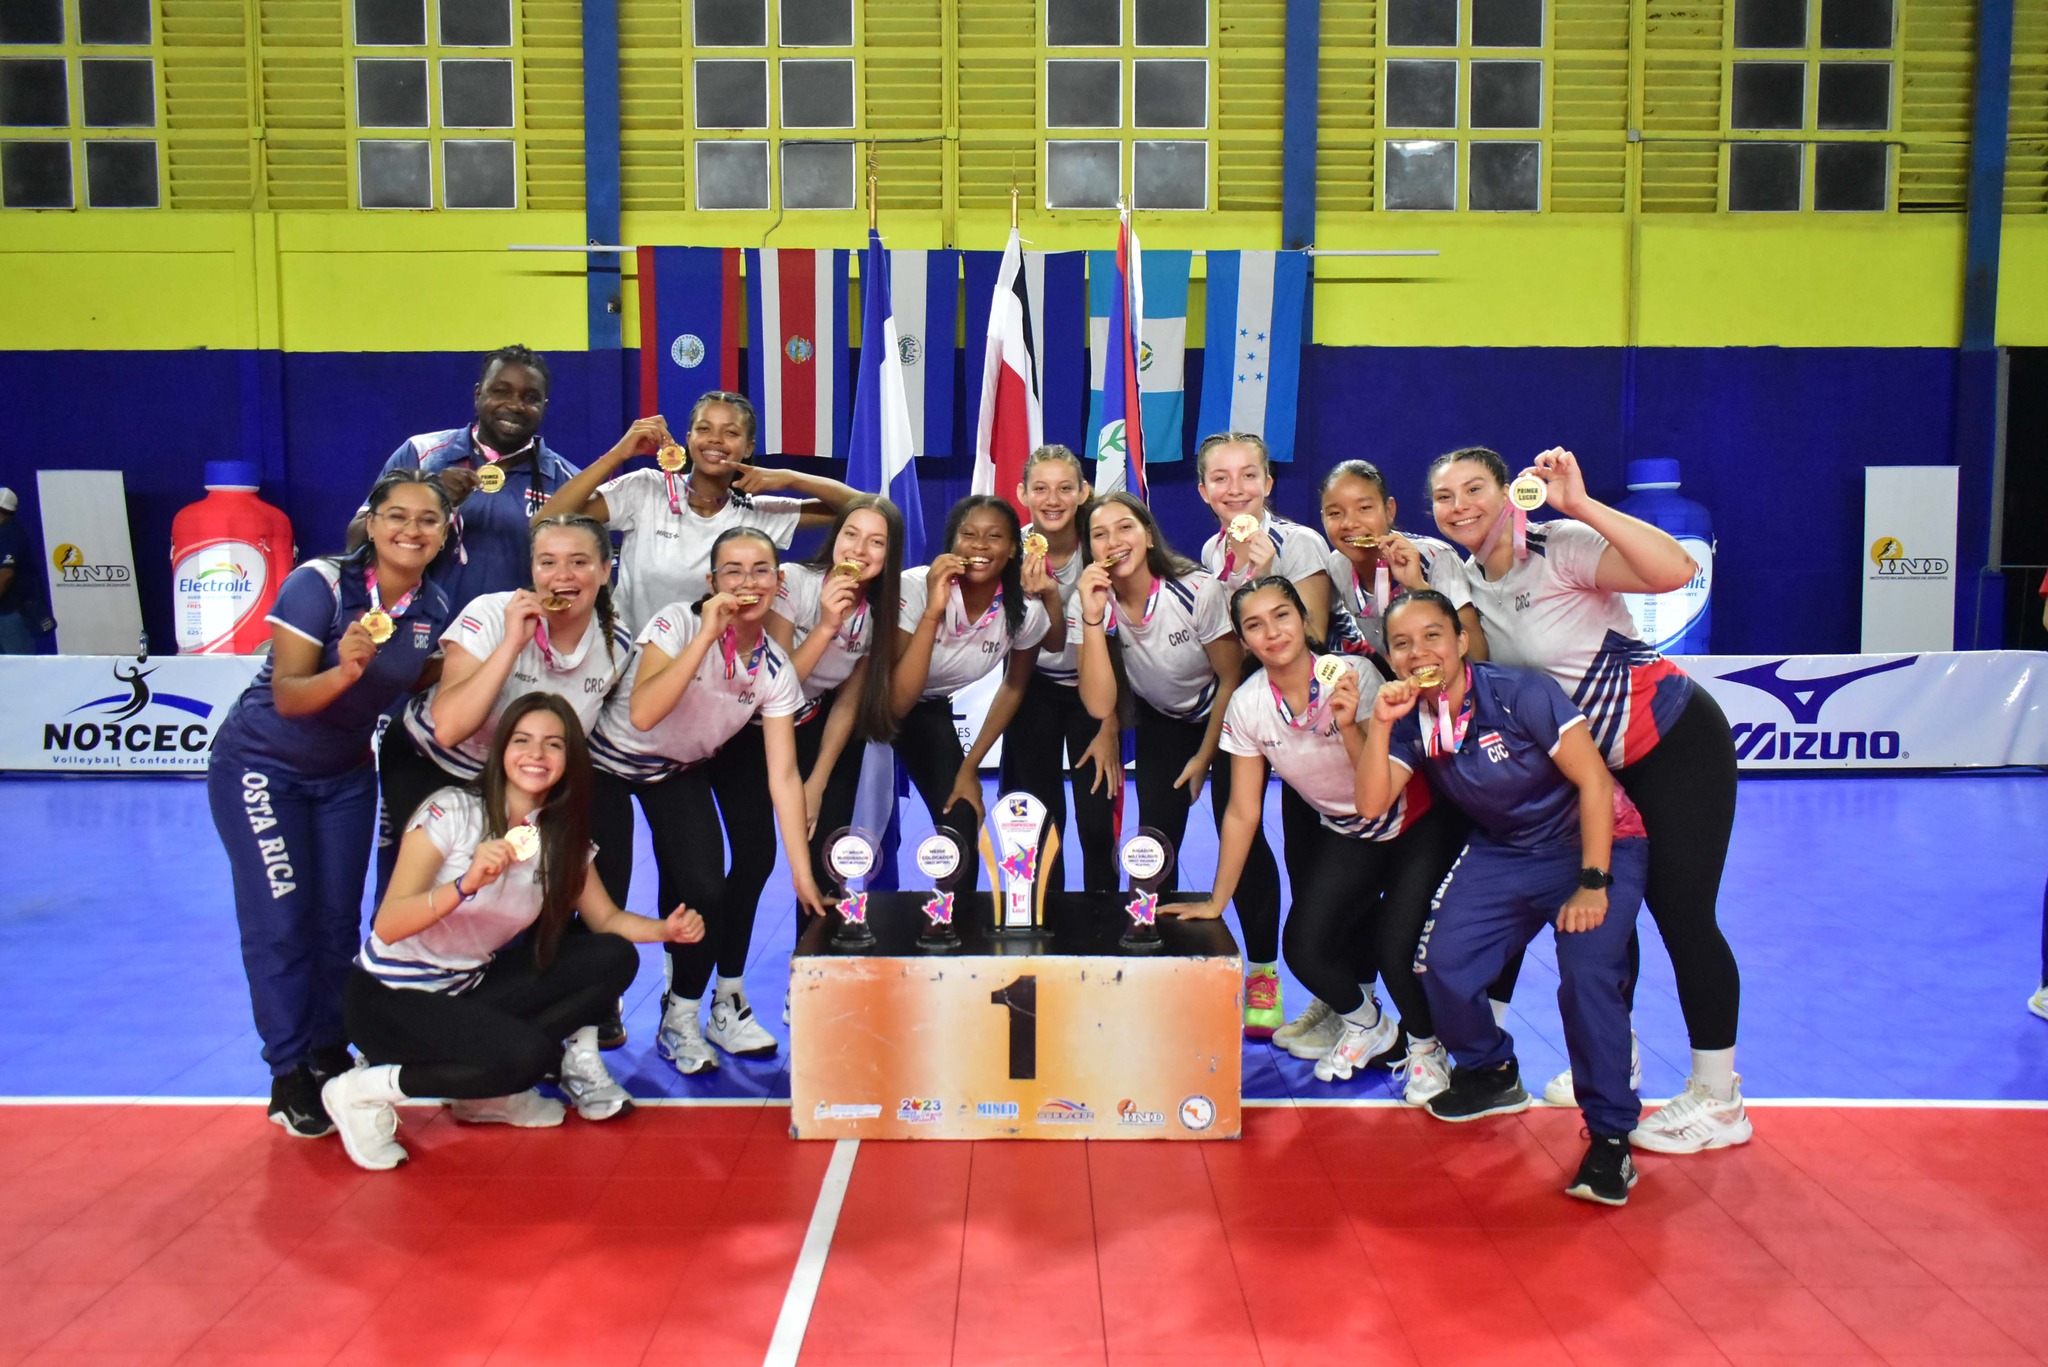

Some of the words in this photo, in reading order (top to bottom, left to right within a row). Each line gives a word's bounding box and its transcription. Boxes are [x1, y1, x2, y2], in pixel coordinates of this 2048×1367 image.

[63, 565, 130, 582] IND
[1878, 558, 1949, 575] IND
[179, 579, 252, 592] Electrolit
[981, 640, 1000, 653] CRC
[1168, 629, 1190, 647] CRC
[584, 677, 605, 693] CRC
[44, 723, 216, 752] NORCEC
[53, 755, 121, 766] Volleyball
[130, 756, 211, 764] Confederati
[242, 767, 278, 835] OSTA
[258, 836, 297, 900] RICA
[991, 975, 1036, 1080] 1
[977, 1103, 1018, 1114] MINED
[1122, 1112, 1165, 1122] IND
